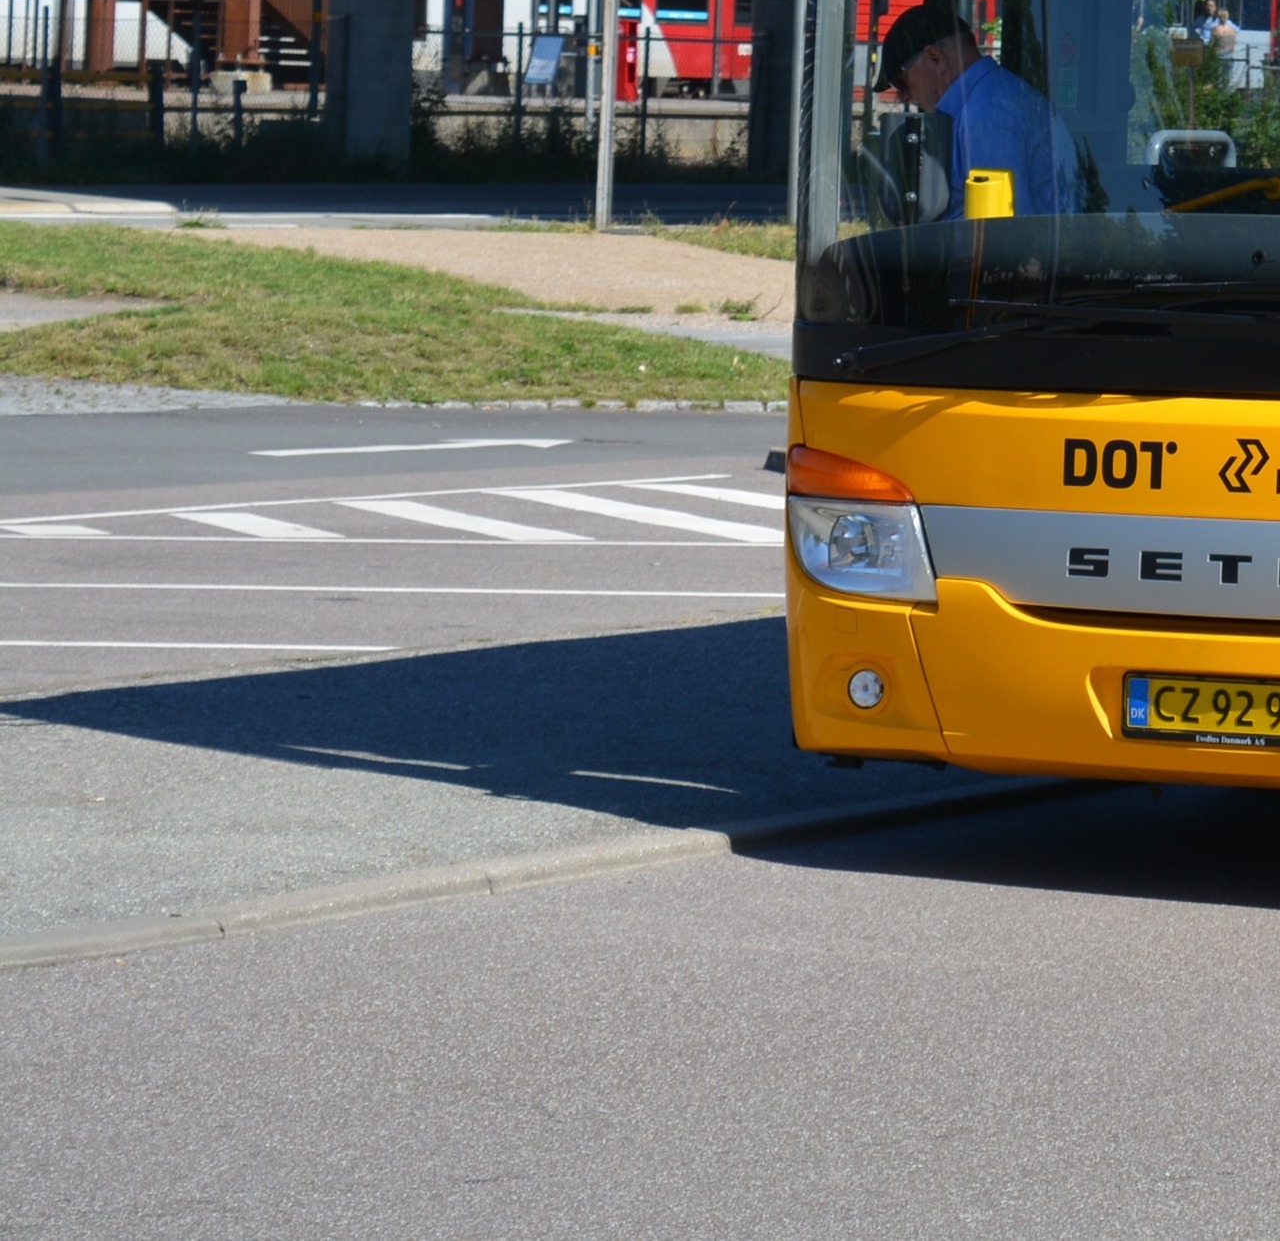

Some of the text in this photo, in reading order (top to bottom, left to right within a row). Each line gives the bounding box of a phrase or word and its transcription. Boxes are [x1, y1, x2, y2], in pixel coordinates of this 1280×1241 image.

[1063, 438, 1178, 490] DOT
[1130, 707, 1146, 719] DK
[1153, 685, 1201, 724] CZ
[1211, 688, 1255, 728] 92
[1221, 735, 1252, 745] Danmark
